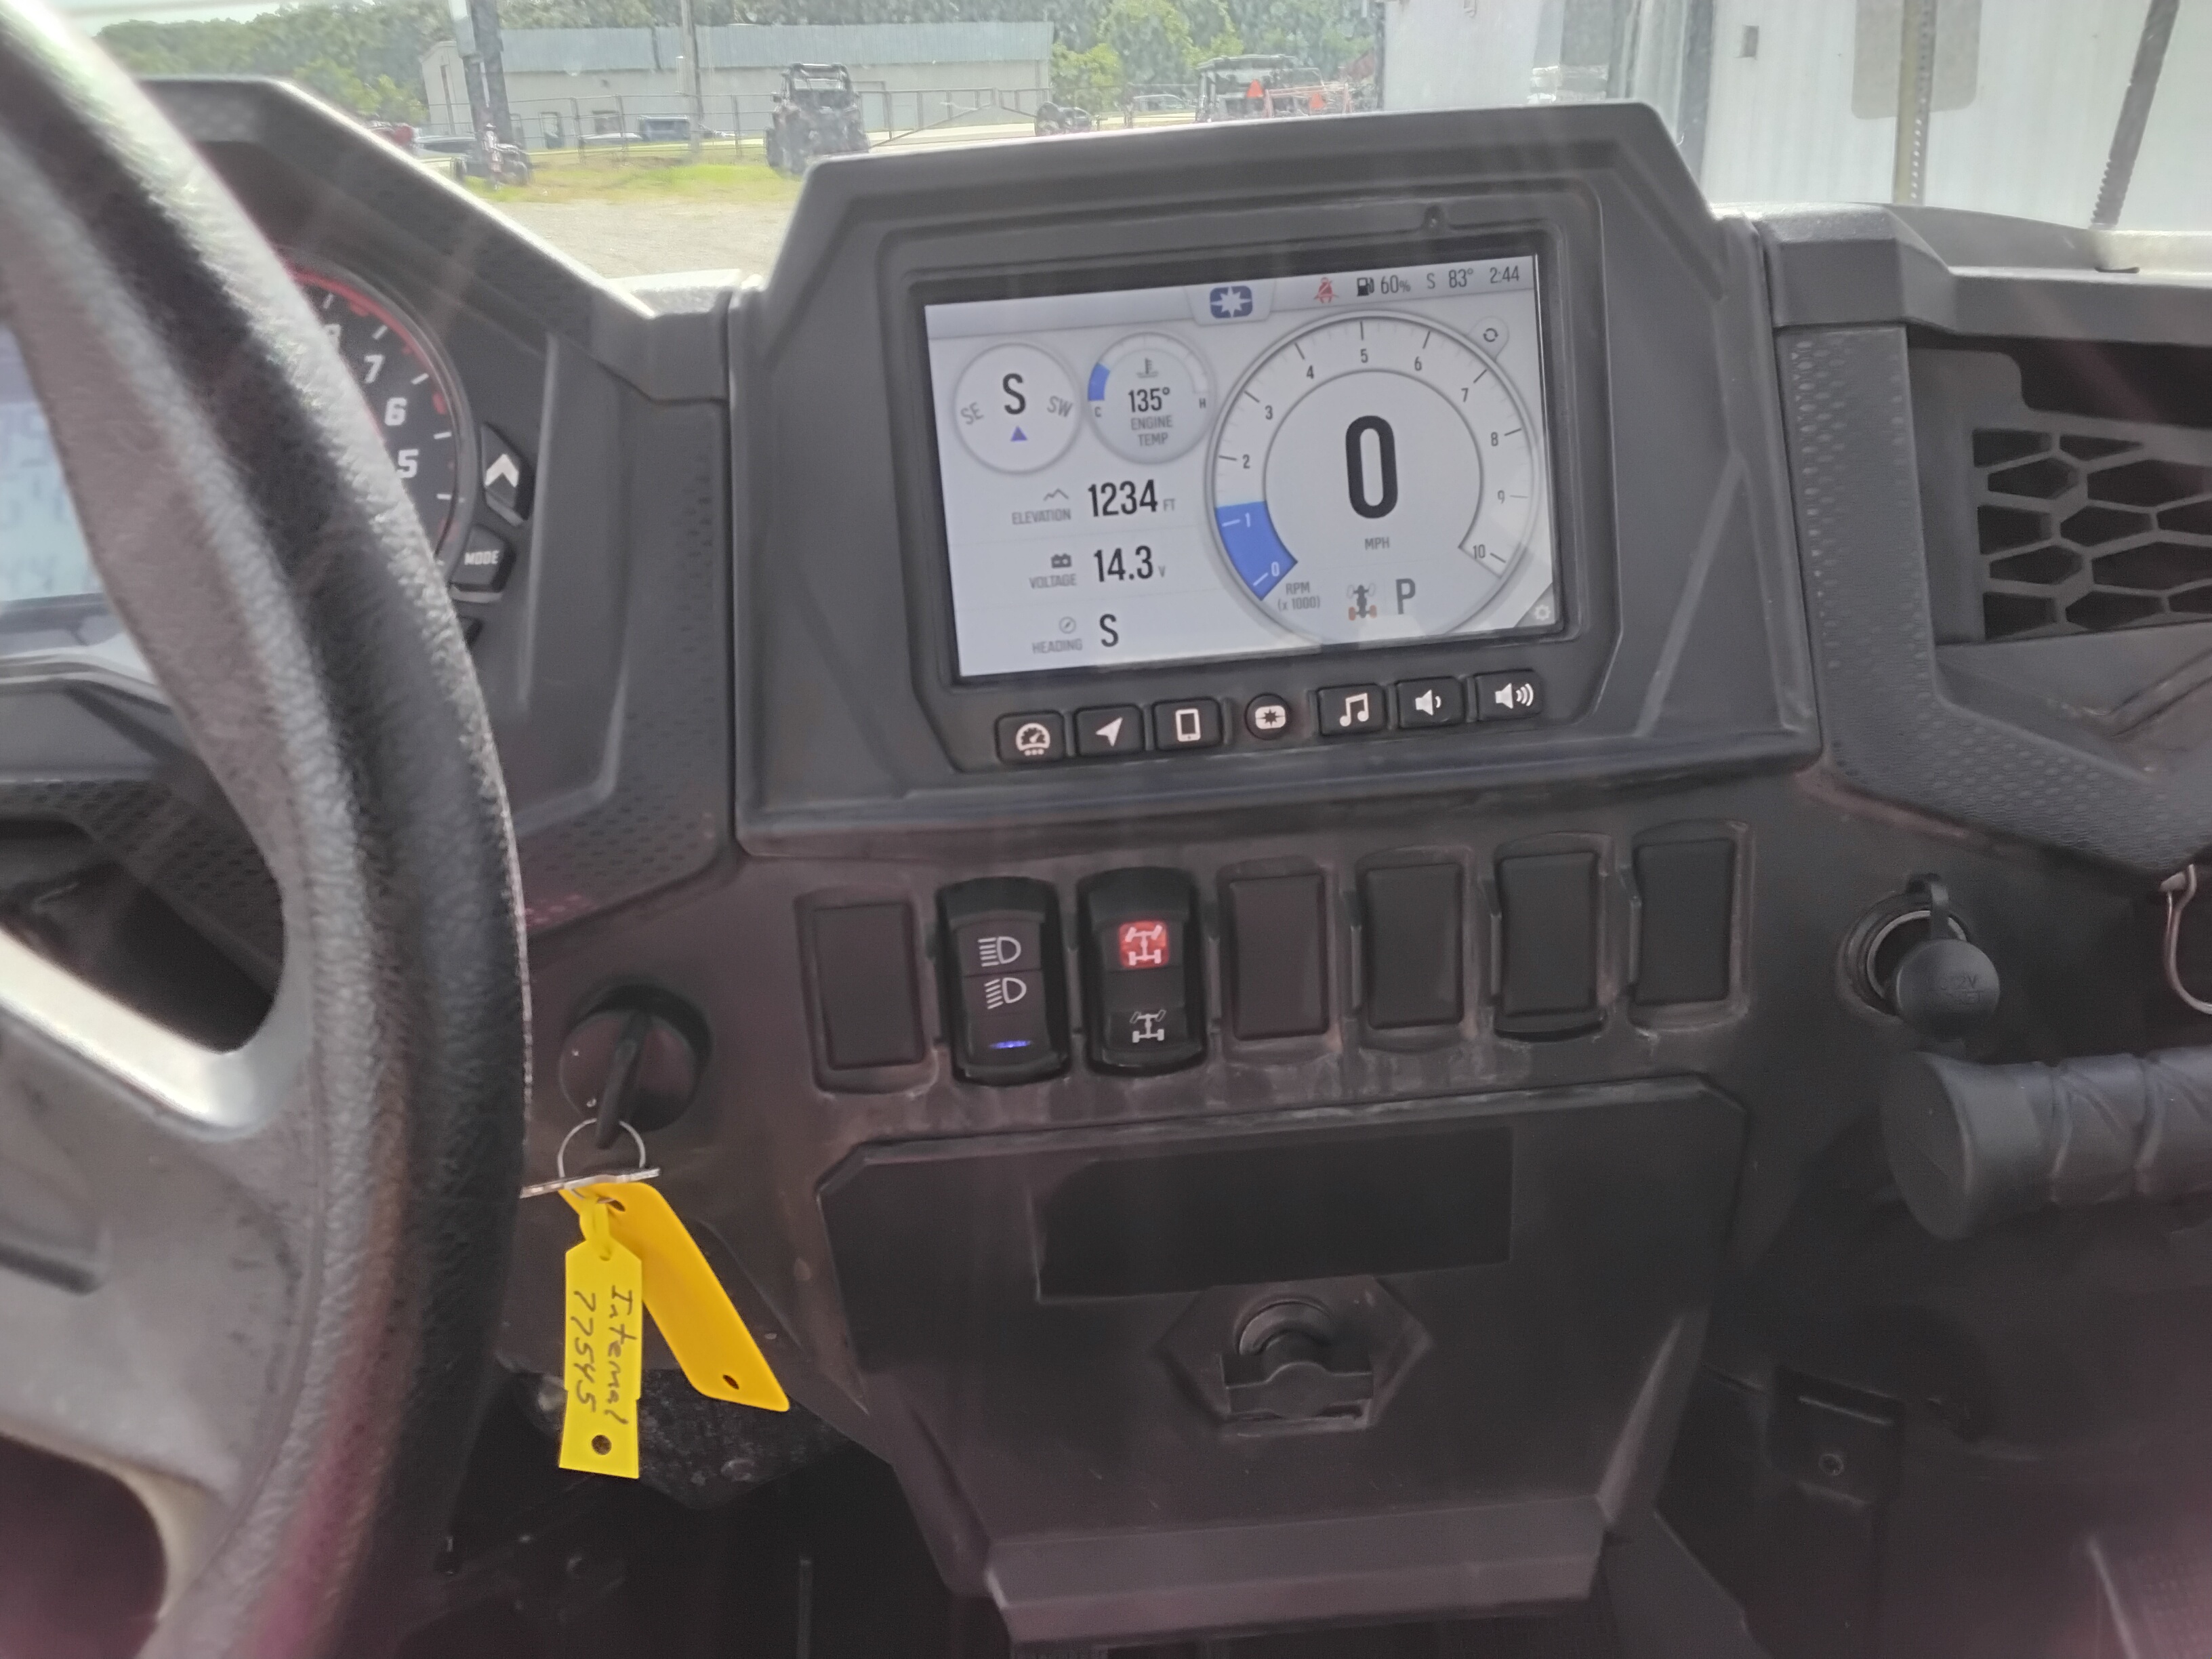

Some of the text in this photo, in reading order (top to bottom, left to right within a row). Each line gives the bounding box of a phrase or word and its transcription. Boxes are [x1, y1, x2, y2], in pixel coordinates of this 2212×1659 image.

[1380, 265, 1519, 295] 60% S 83° 2:44
[1359, 348, 1368, 363] 5
[1414, 356, 1422, 371] 6
[364, 354, 384, 383] 7
[1305, 365, 1315, 380] 4
[1002, 372, 1027, 415] S
[1128, 386, 1170, 413] 135°
[1460, 388, 1469, 403] 7
[384, 397, 407, 426] 6
[1046, 394, 1072, 417] SW
[1199, 398, 1206, 409] H
[960, 402, 984, 425] SE
[1265, 405, 1273, 419] 3
[1130, 414, 1172, 430] ENGINE
[1137, 432, 1168, 447] TEMP
[1490, 432, 1498, 446] 8
[396, 449, 419, 478] 5
[1242, 454, 1250, 468] 2
[1345, 415, 1397, 518] 0
[1088, 478, 1176, 517] 1234 FT
[1497, 490, 1504, 503] 9
[1011, 508, 1071, 525] ELEVATION
[1244, 512, 1250, 527] 1
[1364, 536, 1390, 550] MPH
[464, 550, 499, 565] MODE
[1472, 544, 1486, 559] 10
[1093, 545, 1152, 582] 14.3
[1271, 561, 1279, 576] 0
[1029, 573, 1076, 589] VOLTAGE
[1285, 581, 1310, 594] RPM
[1395, 577, 1416, 614] P
[1099, 613, 1119, 647] S
[1031, 638, 1082, 654] HEADING
[570, 1290, 596, 1413] 77545
[602, 1284, 637, 1425] Internal
